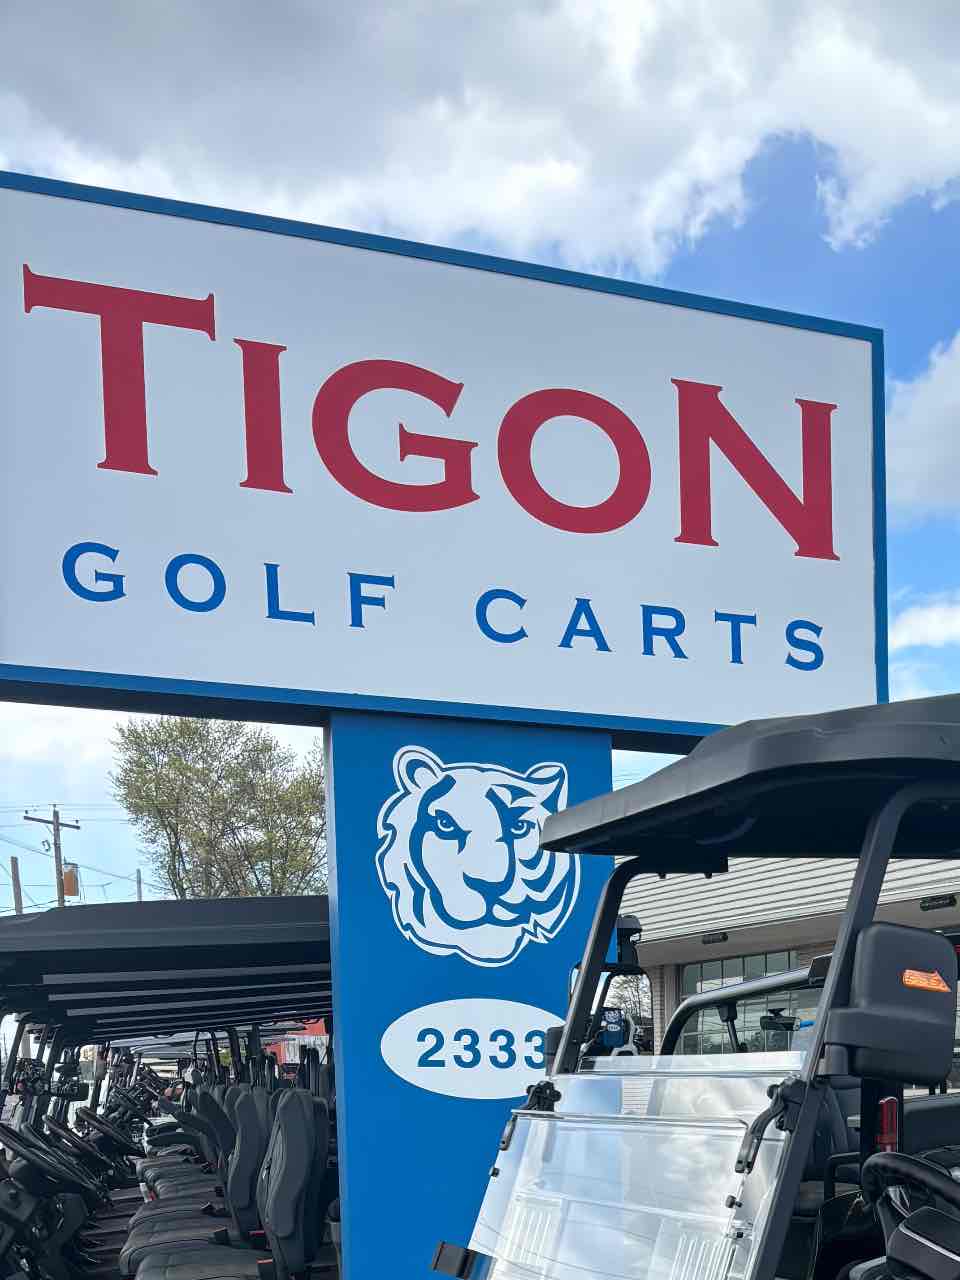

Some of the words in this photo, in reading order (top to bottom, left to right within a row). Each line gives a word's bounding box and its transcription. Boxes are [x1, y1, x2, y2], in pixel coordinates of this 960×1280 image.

[23, 264, 840, 561] TIGON
[61, 541, 396, 630] GOLF
[474, 585, 826, 673] CARTS
[416, 1027, 546, 1070] 2333
